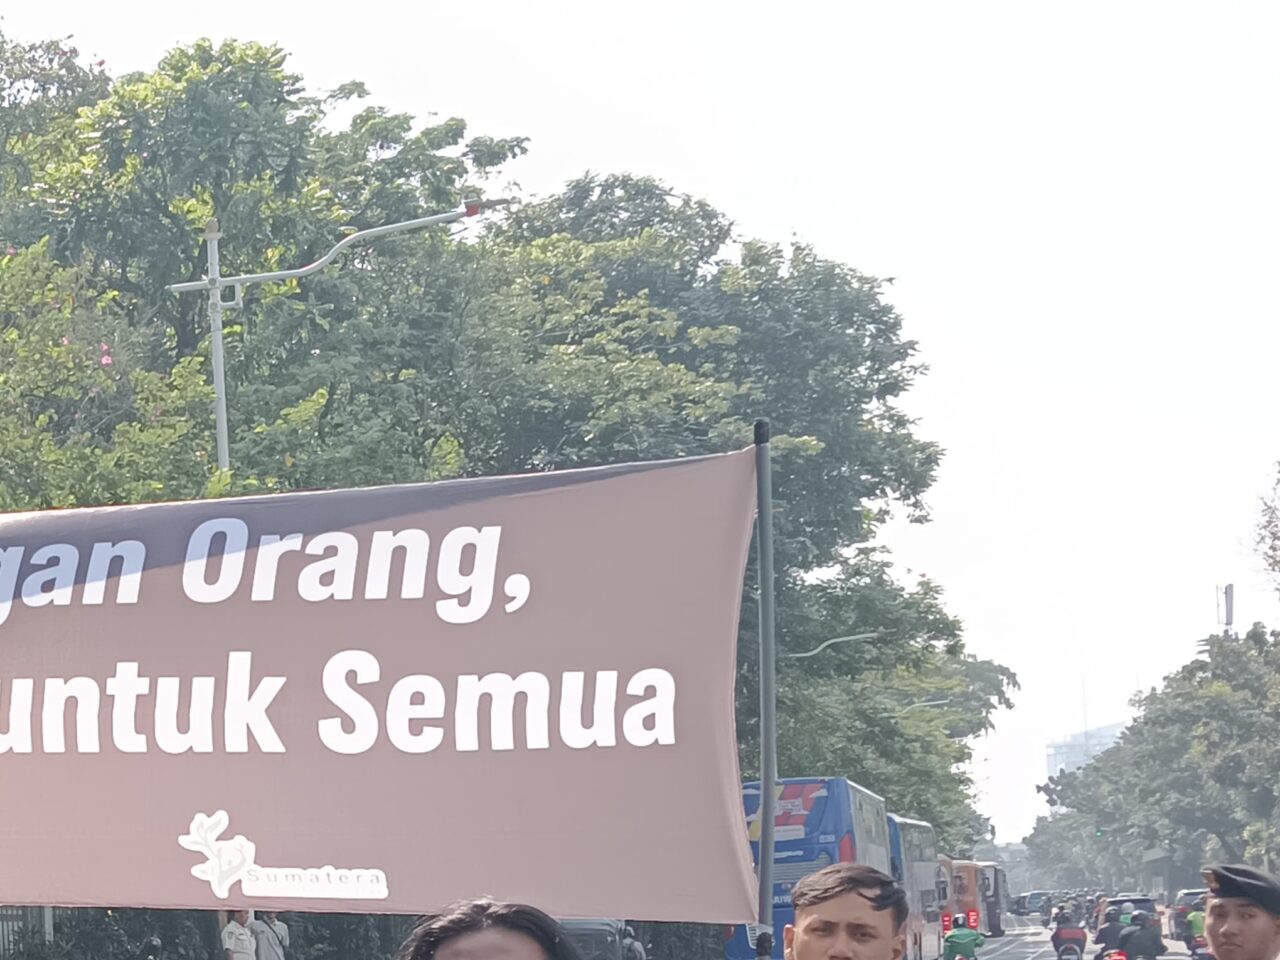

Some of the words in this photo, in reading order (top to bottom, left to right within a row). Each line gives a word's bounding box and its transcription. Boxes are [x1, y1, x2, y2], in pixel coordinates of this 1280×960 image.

[181, 517, 531, 624] Orang,
[317, 649, 676, 754] Semua
[247, 869, 381, 884] Sumatera
